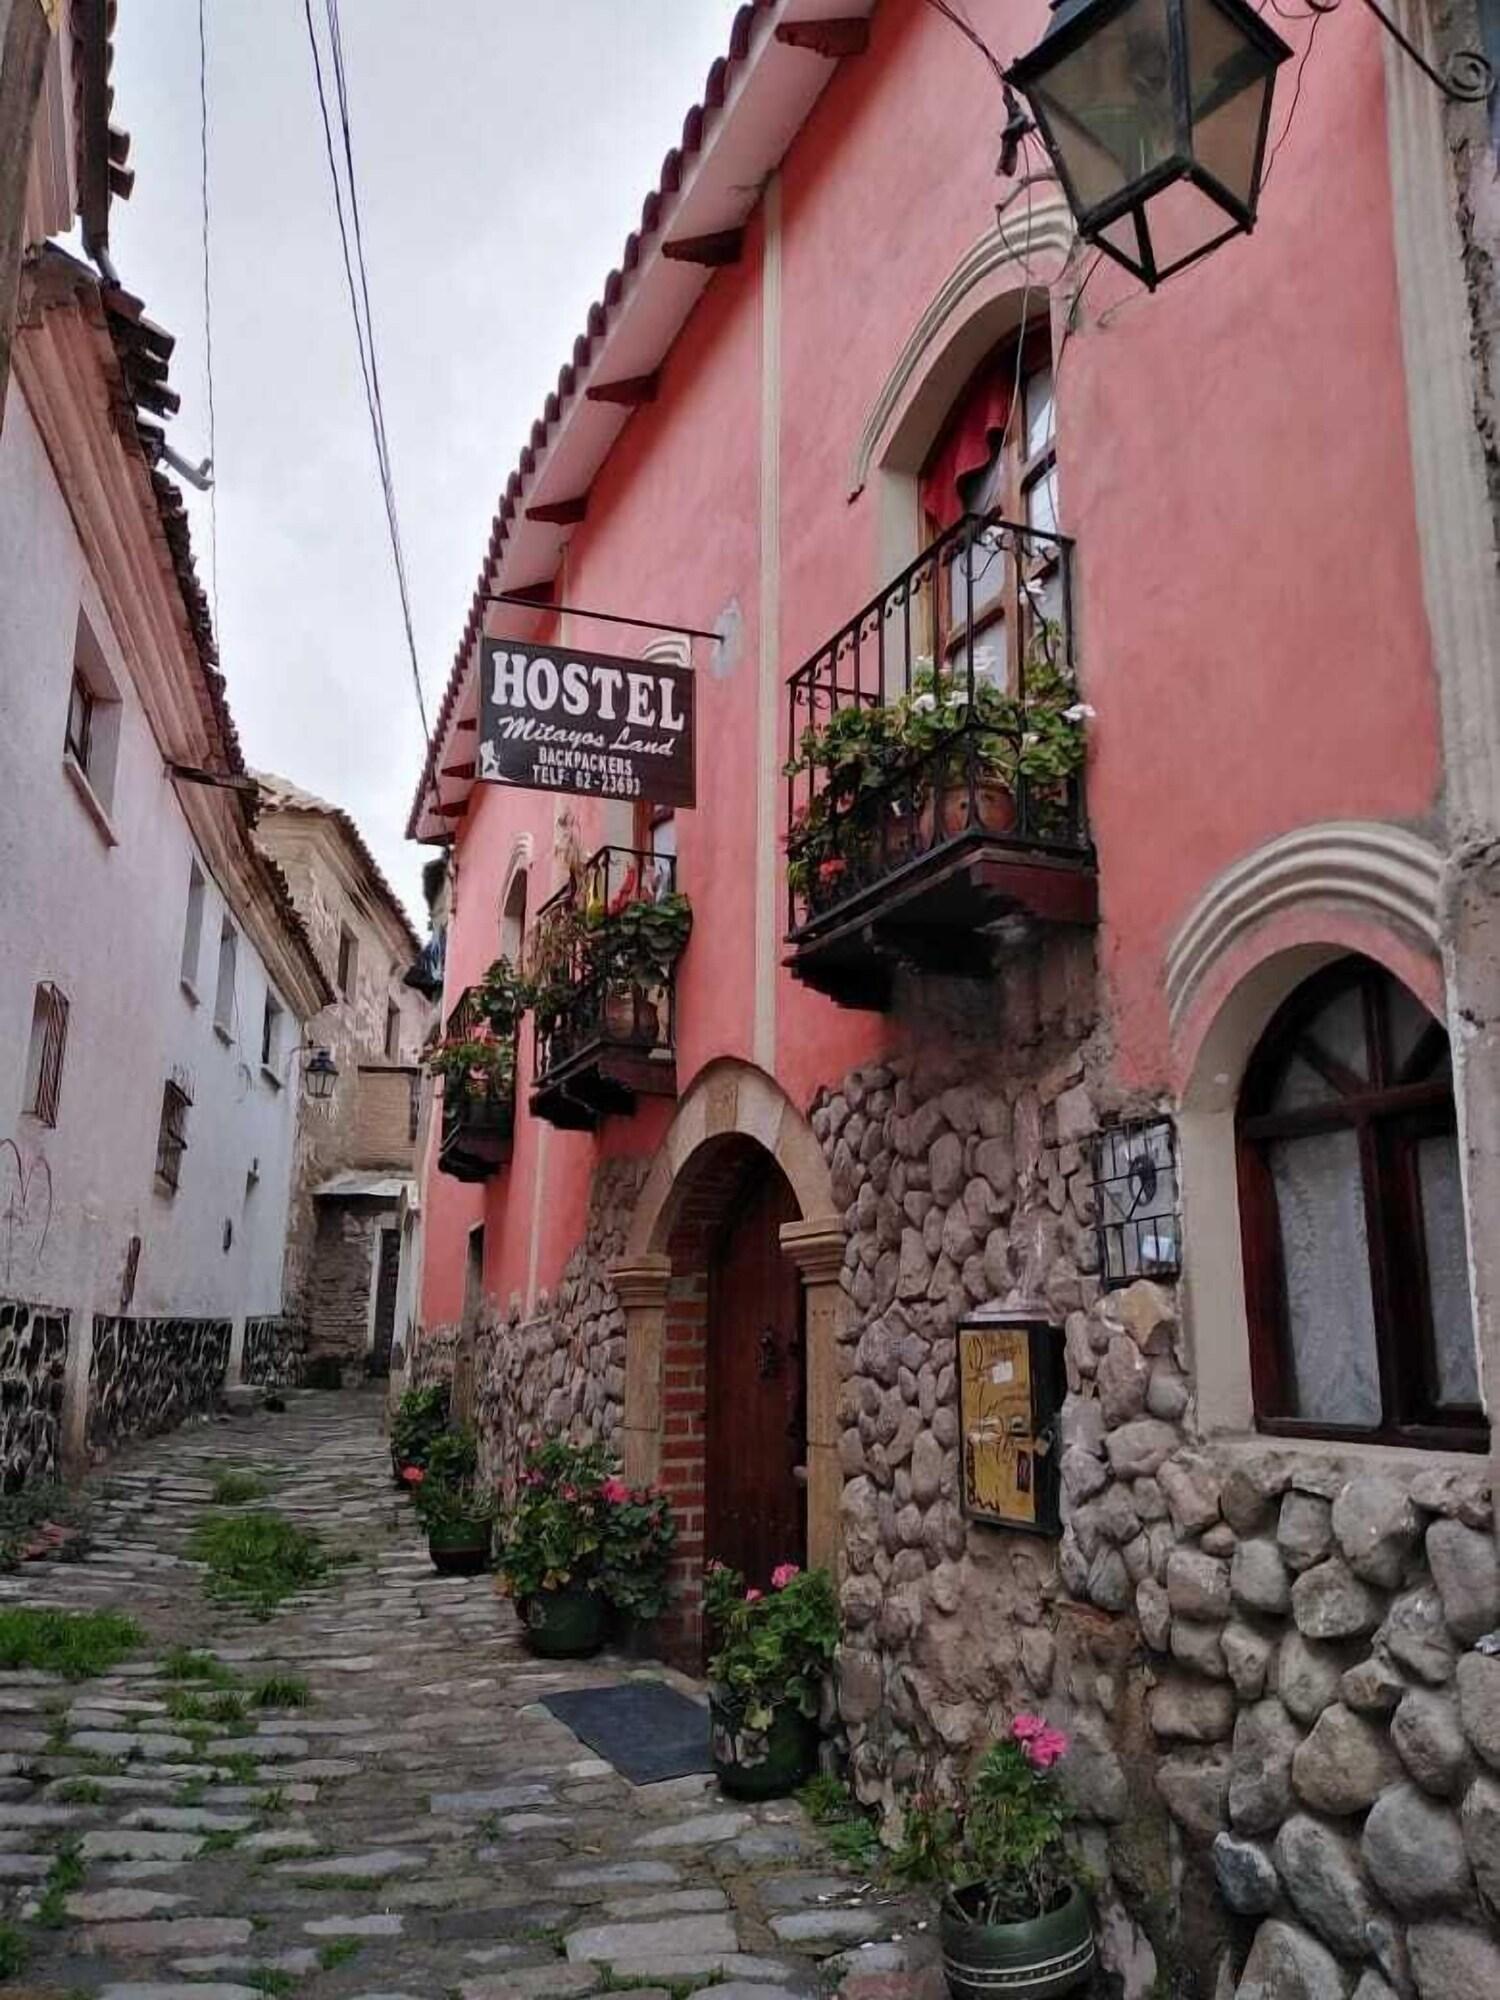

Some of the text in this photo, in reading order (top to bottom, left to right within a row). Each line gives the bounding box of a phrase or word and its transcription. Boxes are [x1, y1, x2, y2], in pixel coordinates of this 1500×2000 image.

[491, 652, 685, 731] HOSTEL
[498, 716, 674, 756] Mitayos Land
[538, 747, 634, 775] BACKPACKERS
